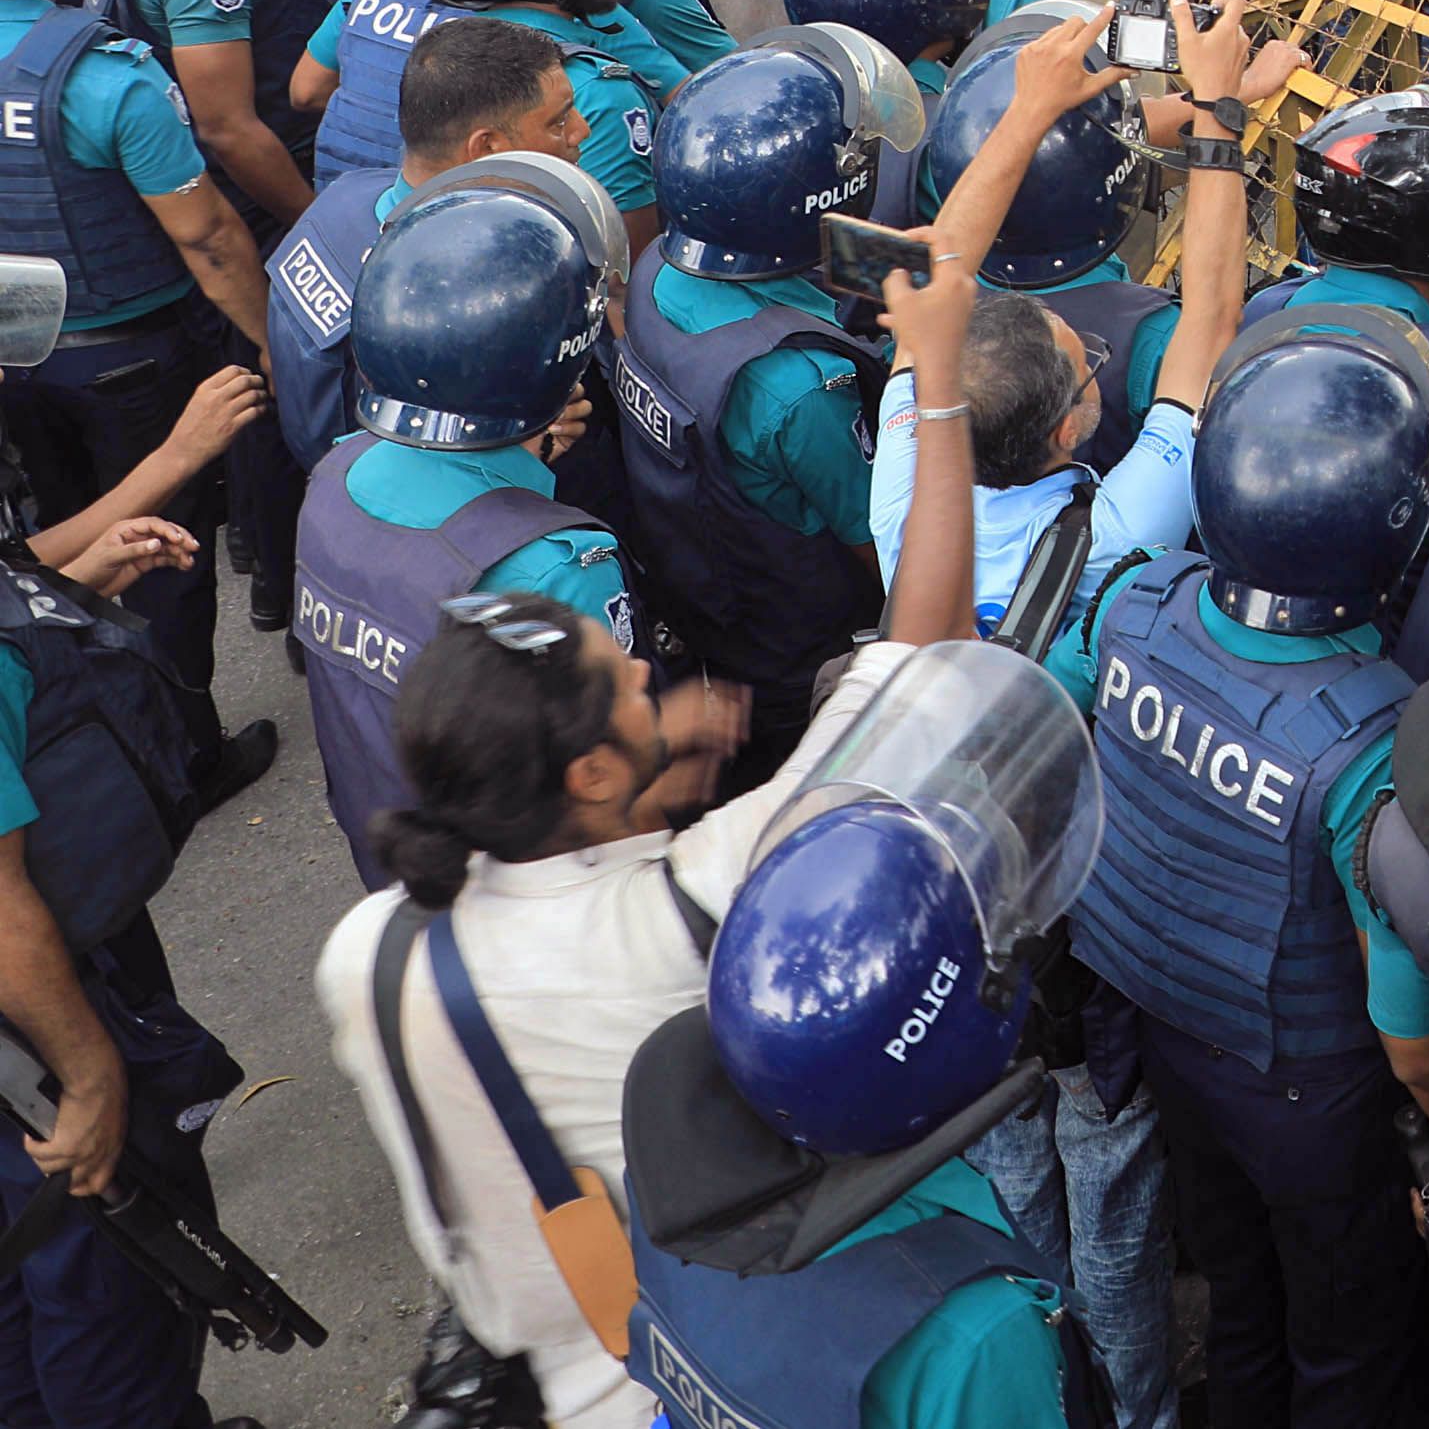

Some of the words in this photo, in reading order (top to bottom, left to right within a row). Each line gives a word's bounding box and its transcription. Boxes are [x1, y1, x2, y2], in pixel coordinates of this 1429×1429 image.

[805, 171, 869, 215] POLICE
[287, 253, 348, 332] POLICE
[618, 369, 669, 442] POLICE
[300, 586, 406, 684] POLICE
[1102, 656, 1294, 827] POLICE
[884, 956, 962, 1063] POLICE
